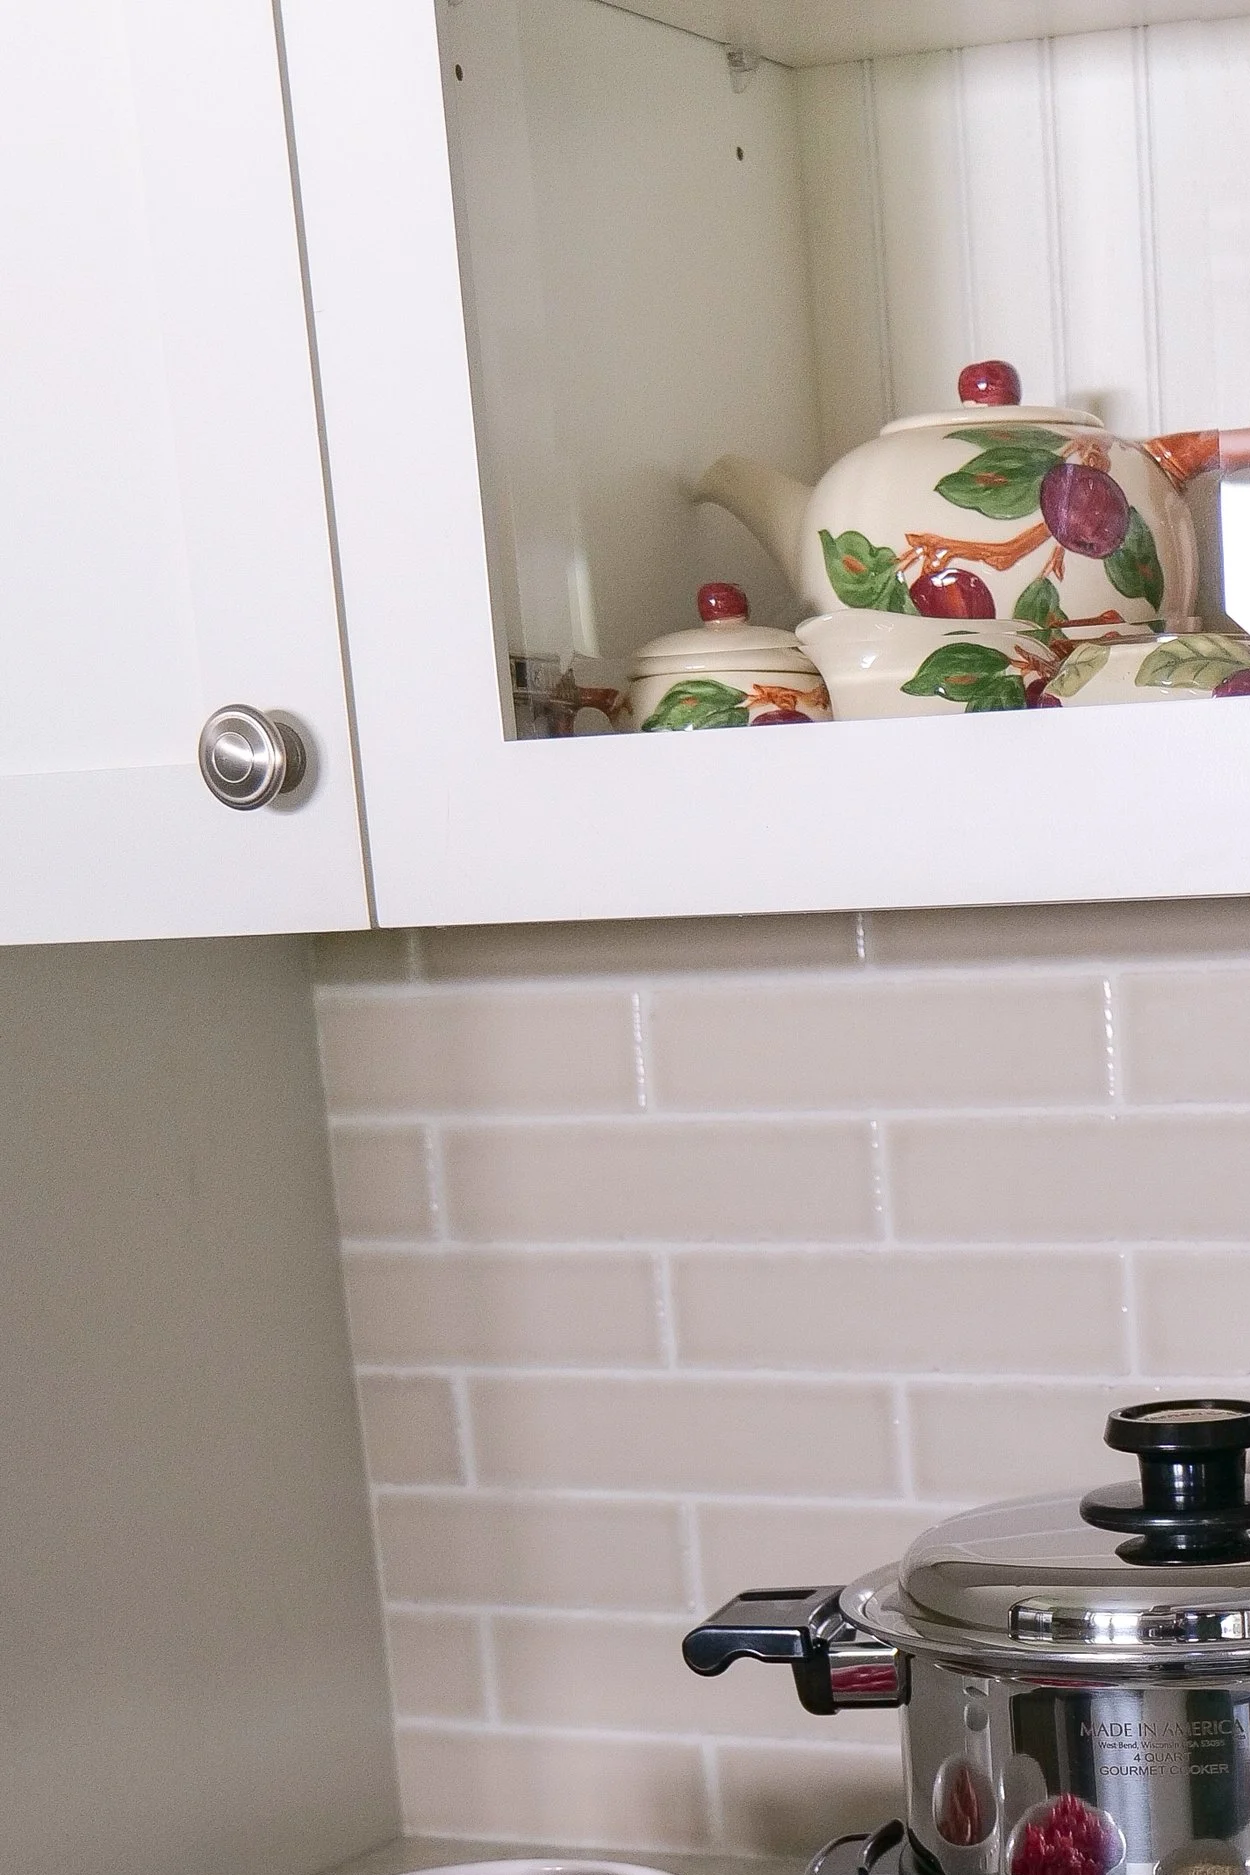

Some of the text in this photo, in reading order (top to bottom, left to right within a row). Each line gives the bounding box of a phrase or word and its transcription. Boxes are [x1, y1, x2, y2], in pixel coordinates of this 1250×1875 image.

[1080, 1718, 1245, 1737] MADE IN AMERICA
[1098, 1740, 1117, 1750] West
[1118, 1740, 1139, 1751] Bend,
[1140, 1740, 1180, 1750] Wisconsn
[1133, 1751, 1193, 1763] 4 QUART
[1099, 1762, 1230, 1776] GOURMET COOKER
